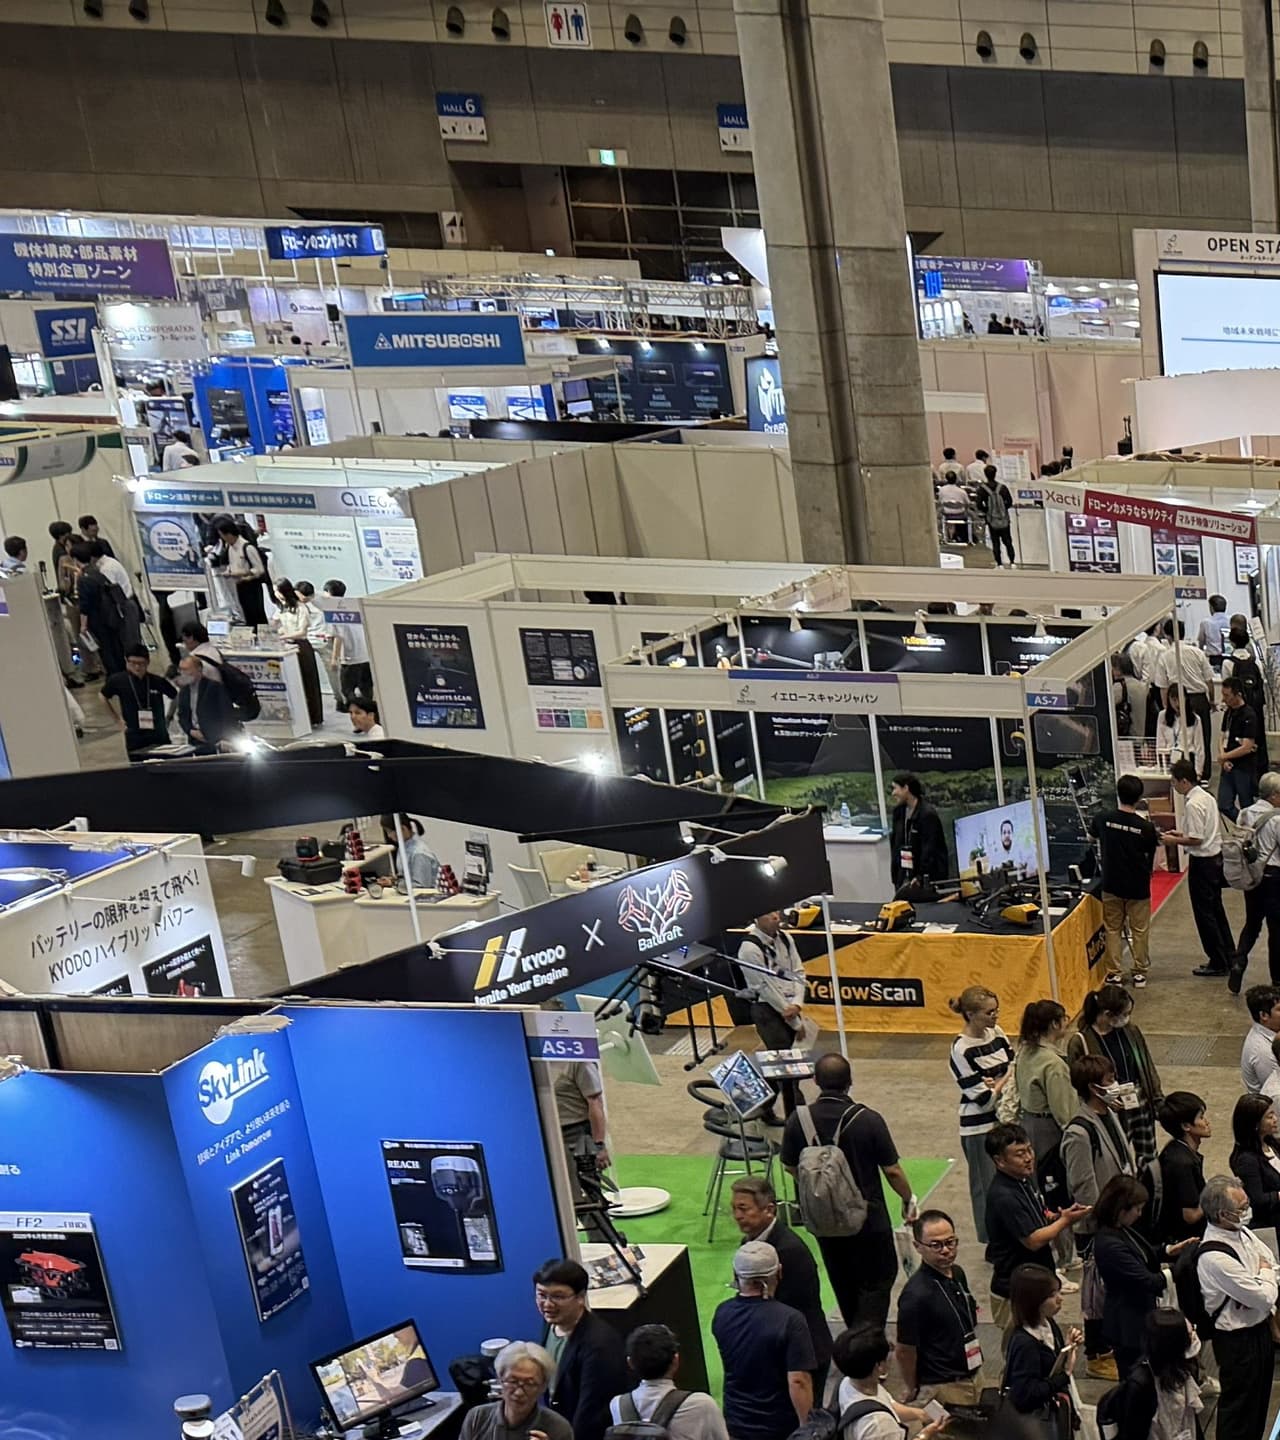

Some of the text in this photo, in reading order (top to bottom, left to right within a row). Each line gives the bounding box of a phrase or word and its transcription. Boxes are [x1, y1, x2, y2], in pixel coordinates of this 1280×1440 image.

[443, 98, 476, 114] HALL 6
[1207, 237, 1250, 253] OPEN
[50, 318, 87, 341] SSI
[392, 333, 501, 349] MITSUBOSHI
[1045, 489, 1081, 508] Xacti
[331, 613, 355, 622] AT-7
[771, 692, 879, 704] イエロースキャンジャパン
[1034, 696, 1059, 705] AS-7
[638, 925, 685, 952] Batcraft
[521, 944, 567, 973] KYODO
[48, 949, 92, 985] KYODO
[475, 966, 569, 1006] Ignite Your Engine
[806, 979, 918, 1001] YelowScan
[542, 1040, 585, 1055] AS-3
[198, 1047, 269, 1108] SkyLink
[388, 1160, 420, 1170] REACH
[16, 1216, 43, 1228] FF2
